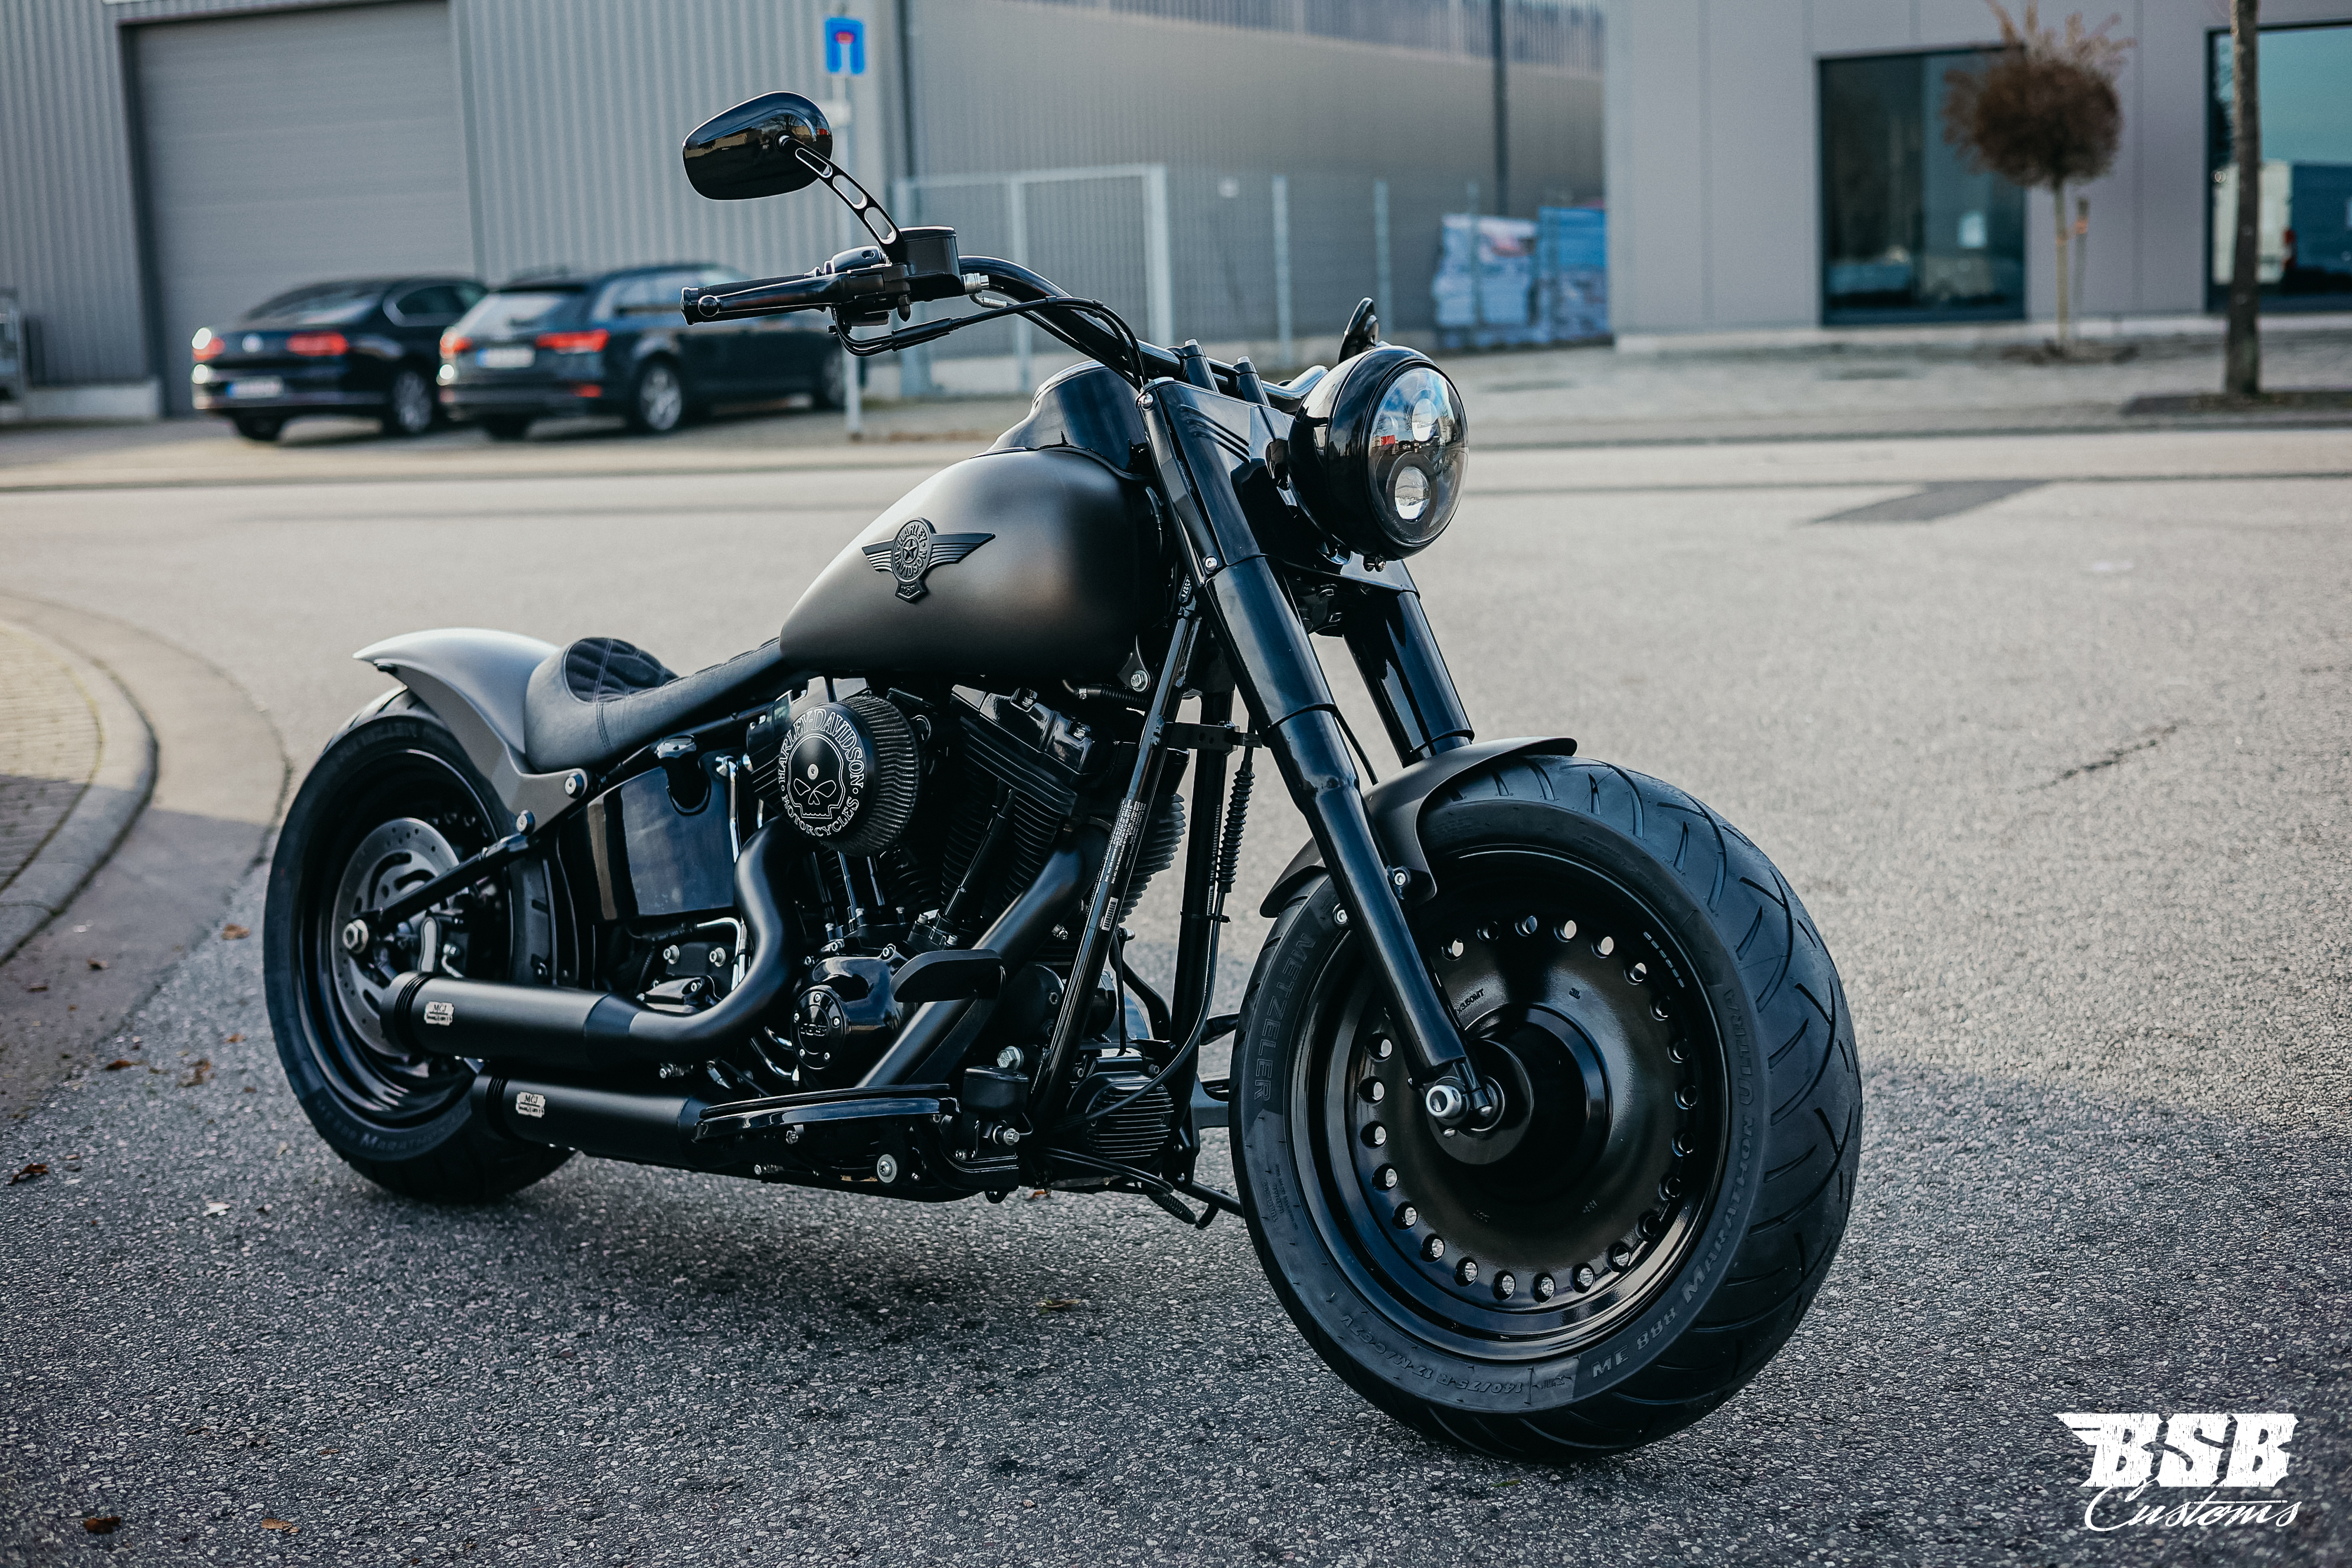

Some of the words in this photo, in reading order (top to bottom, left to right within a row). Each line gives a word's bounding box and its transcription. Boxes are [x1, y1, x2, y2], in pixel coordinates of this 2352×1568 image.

[897, 524, 927, 547] HARLEY
[894, 550, 927, 579] DAVIDSON
[778, 708, 865, 789] HARLEY-DAVIDSON
[781, 792, 860, 837] MOTORCYCLES
[433, 1004, 447, 1012] MCJ
[1454, 988, 1485, 1014] x3.50MT
[1253, 932, 1317, 1102] METZELER
[524, 1094, 538, 1103] MCJ
[1590, 1345, 1629, 1378] ME
[1636, 1305, 1677, 1351] 888
[1412, 1366, 1433, 1380] 17
[1454, 1379, 1524, 1394] 140/75
